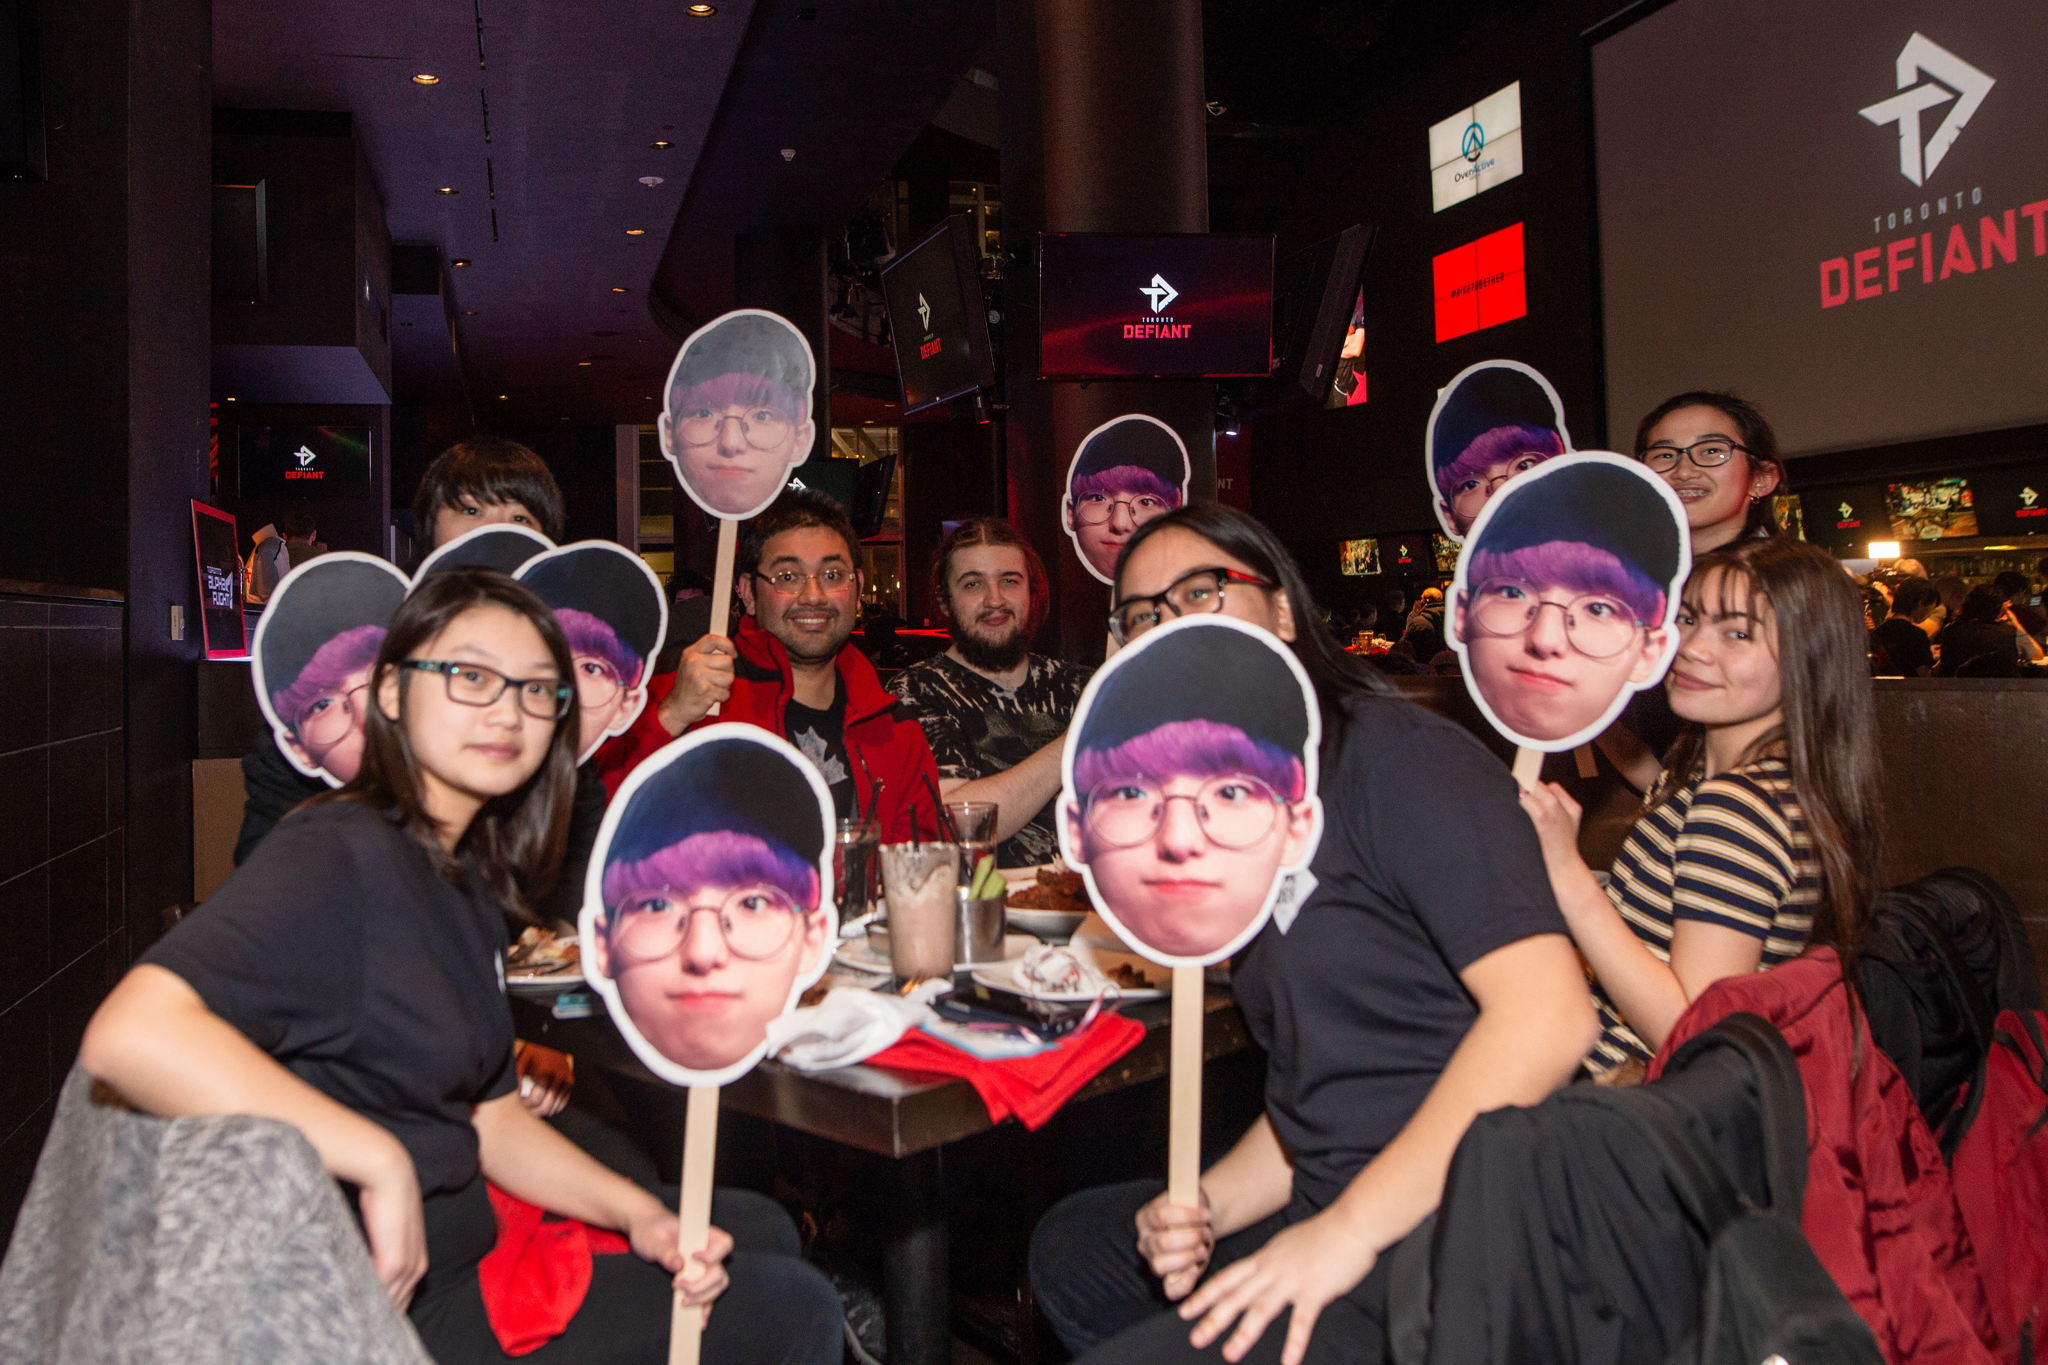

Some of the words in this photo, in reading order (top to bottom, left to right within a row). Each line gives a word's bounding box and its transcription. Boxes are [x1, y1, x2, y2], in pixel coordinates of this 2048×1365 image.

[1873, 187, 1982, 233] TORONTO
[1820, 199, 2048, 309] DEFIANT
[1124, 324, 1192, 339] DEFIANT
[285, 471, 325, 479] DEFIANT
